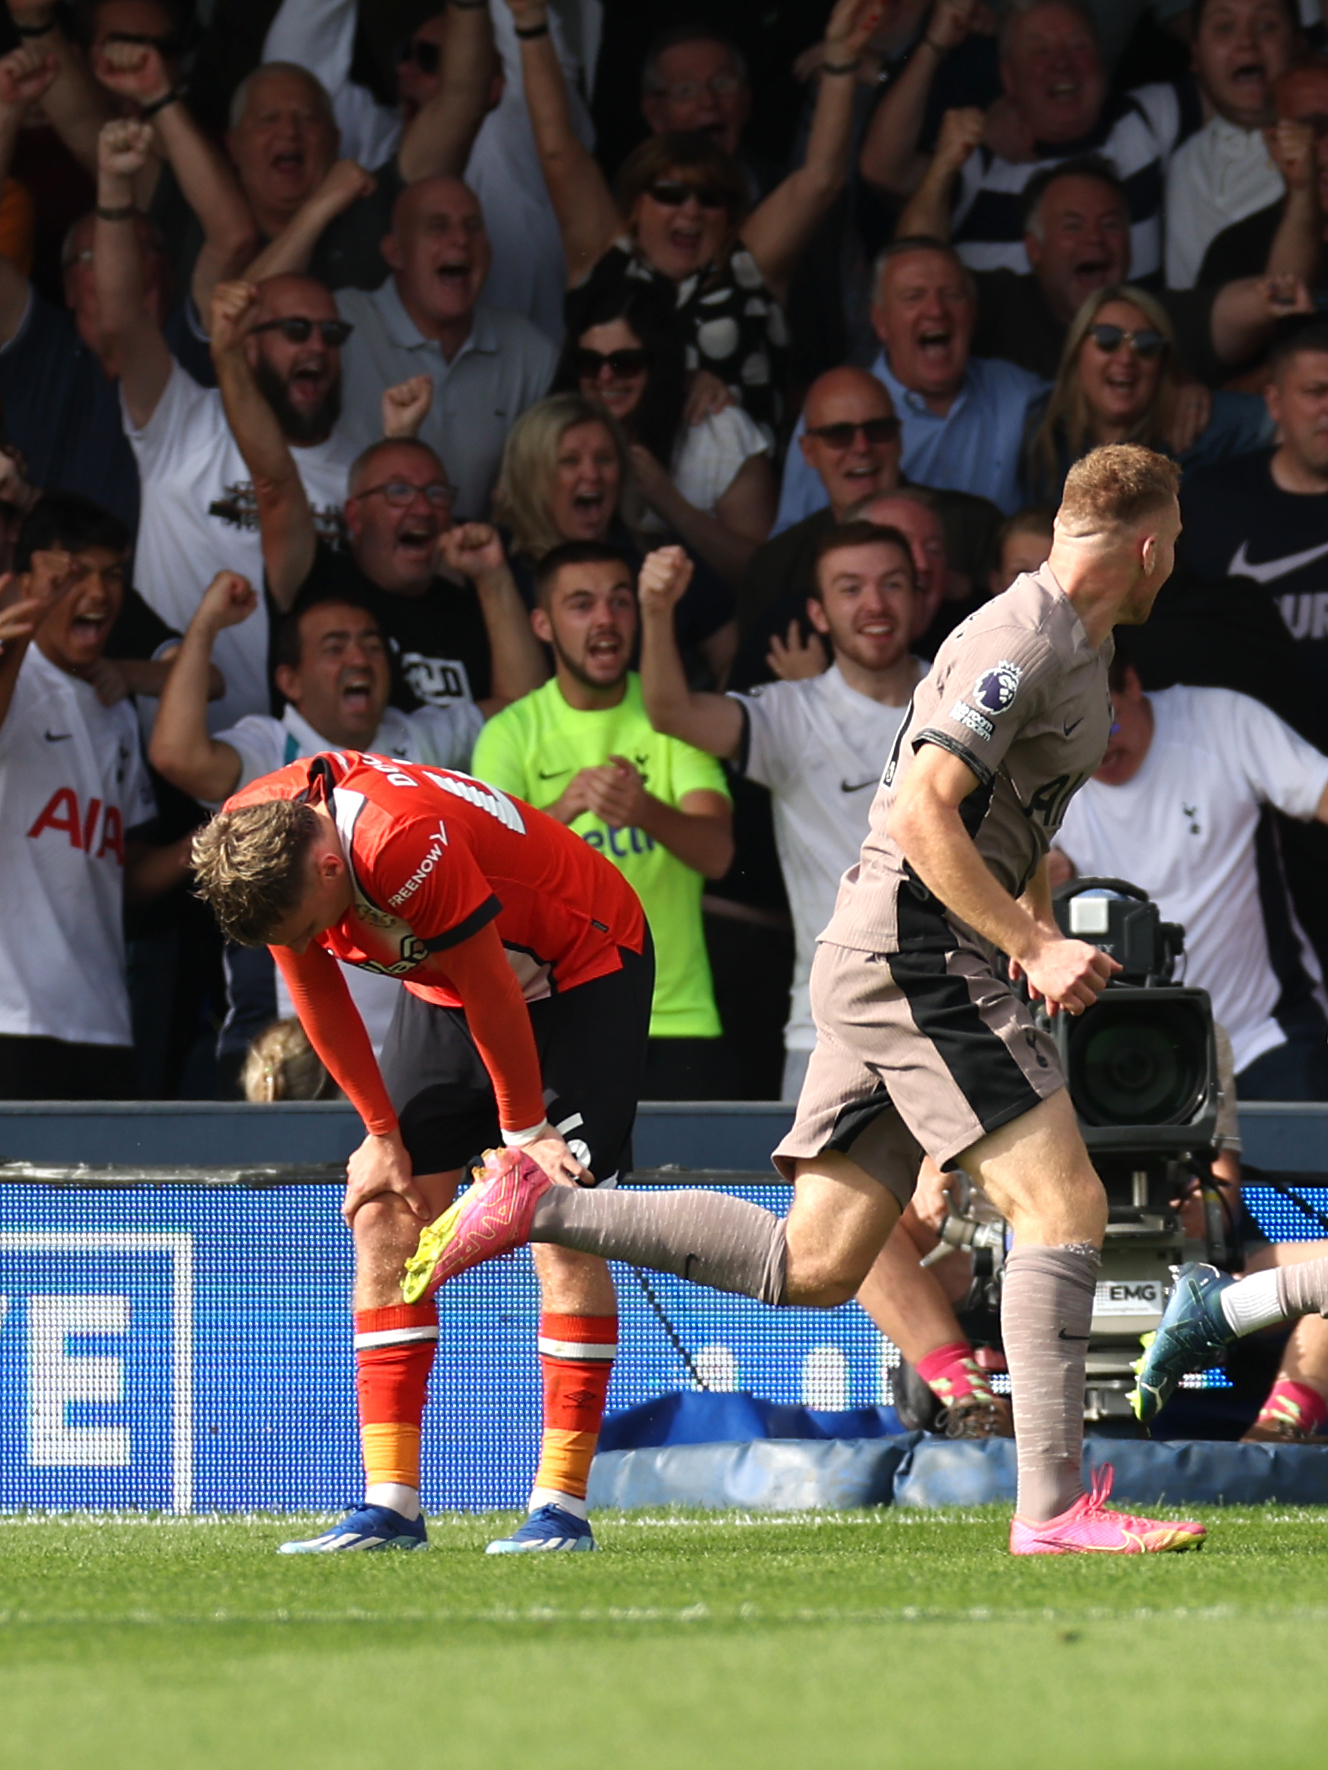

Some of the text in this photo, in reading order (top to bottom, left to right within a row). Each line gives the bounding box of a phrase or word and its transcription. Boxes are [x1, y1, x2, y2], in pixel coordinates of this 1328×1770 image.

[26, 785, 125, 867] AIA
[388, 843, 443, 908] FREENOW
[1110, 1284, 1157, 1301] EMG
[0, 1295, 131, 1466] E
